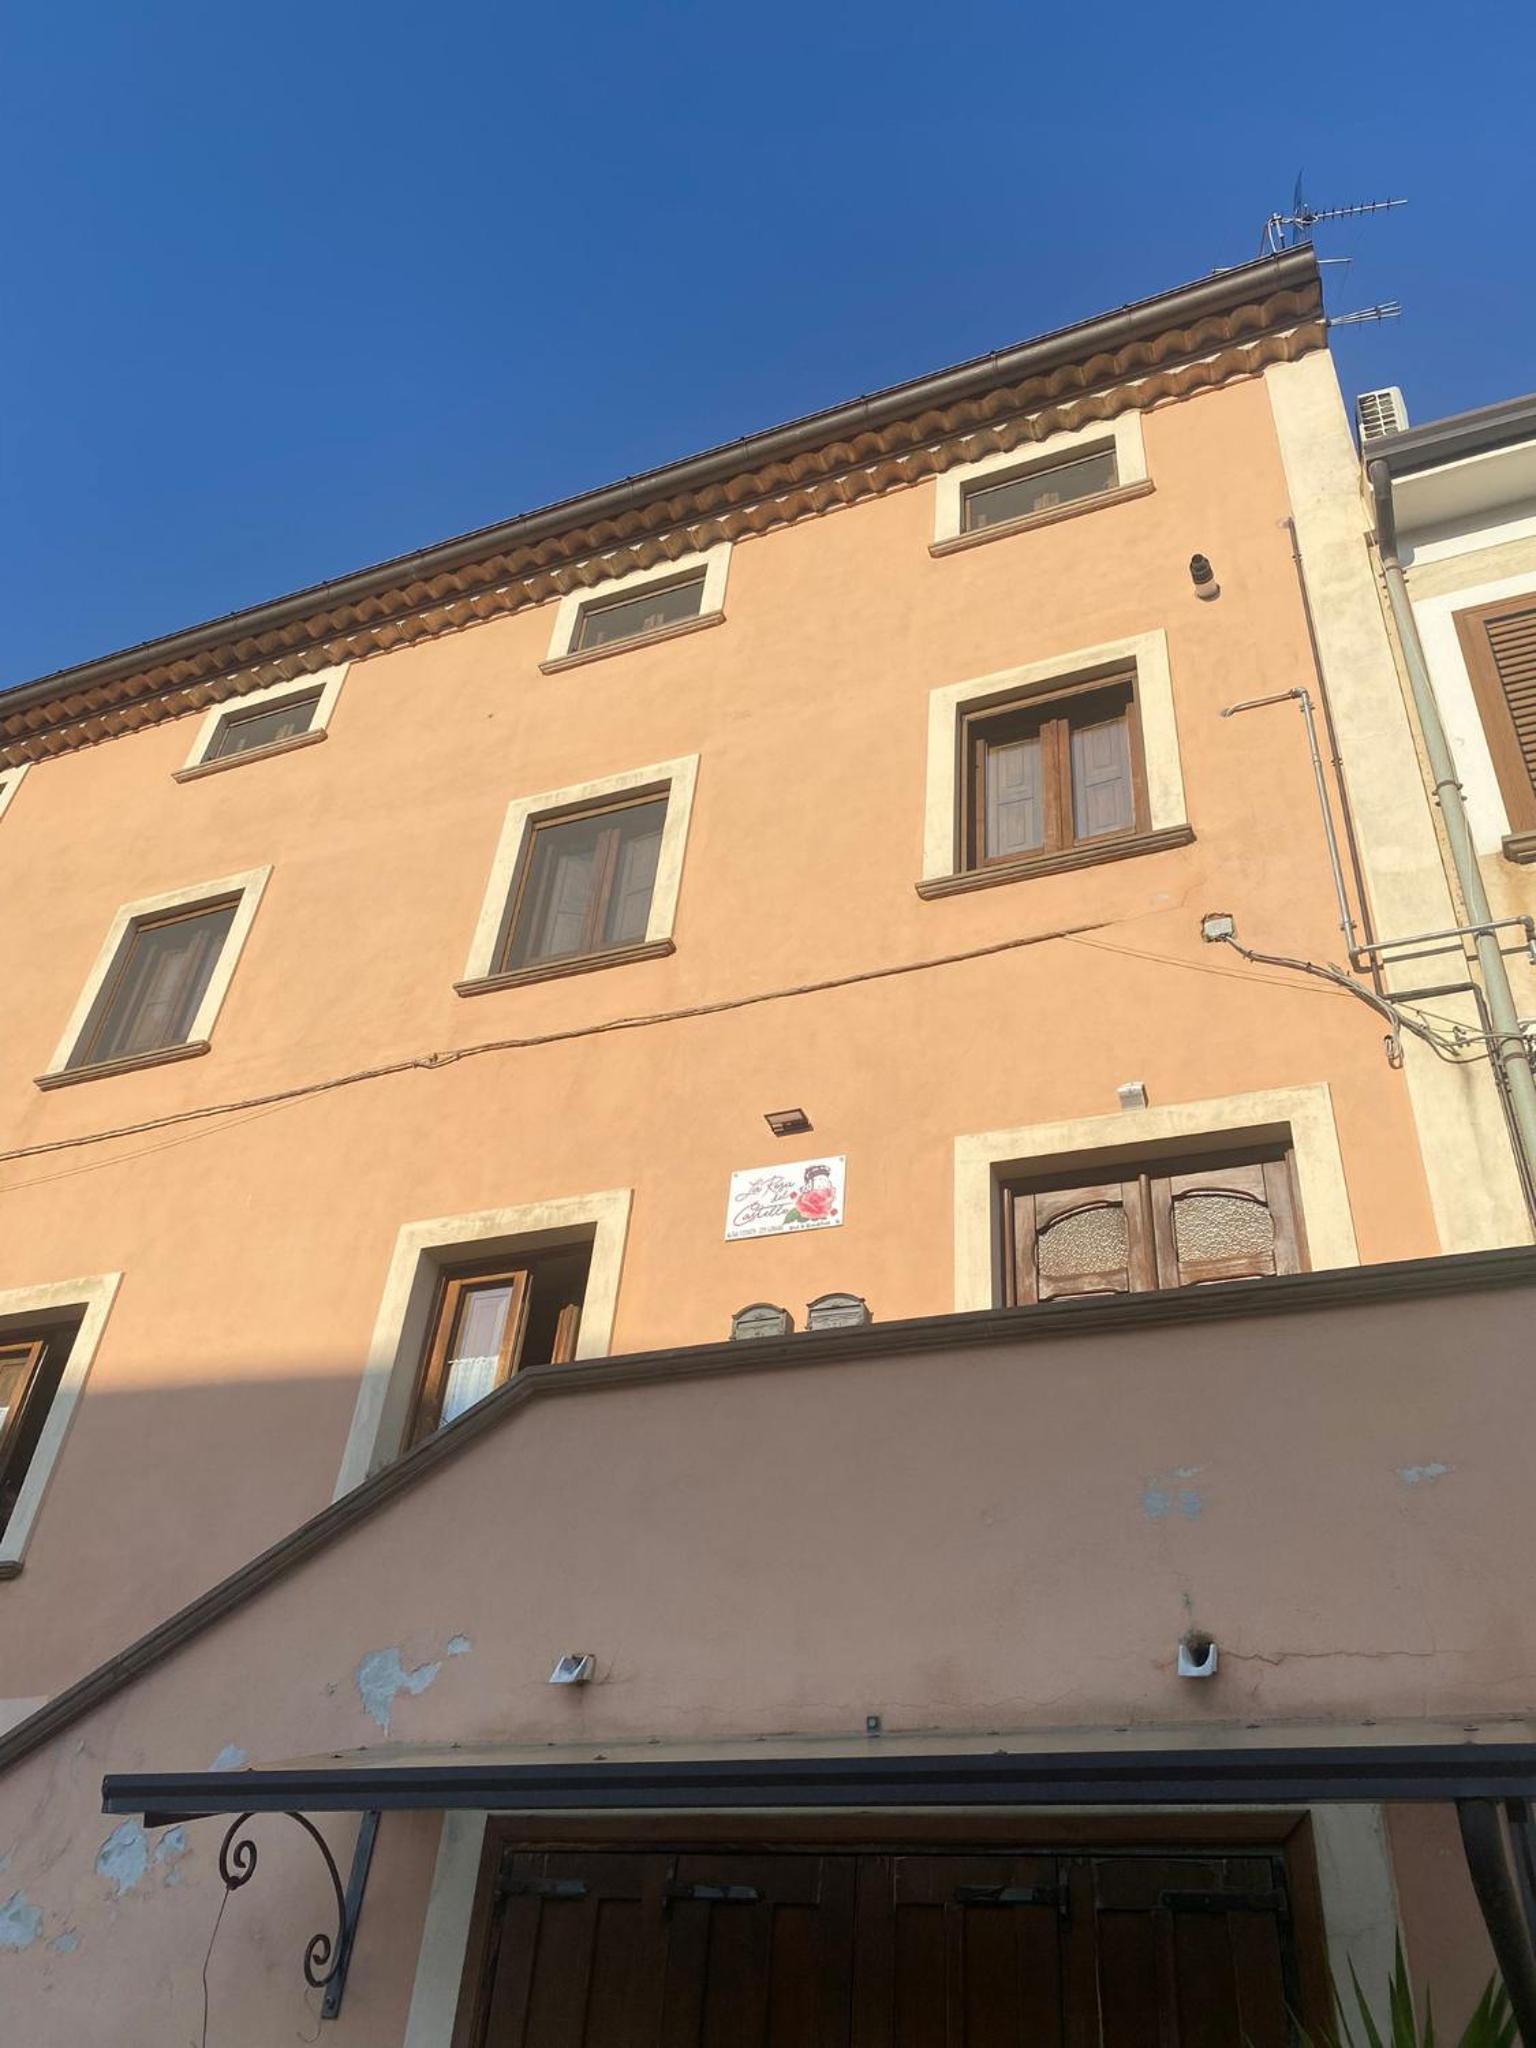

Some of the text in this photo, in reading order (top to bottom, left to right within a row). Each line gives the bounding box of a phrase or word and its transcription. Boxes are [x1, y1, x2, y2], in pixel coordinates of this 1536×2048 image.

[735, 1175, 795, 1202] La Rosa
[732, 1200, 792, 1227] Castello
